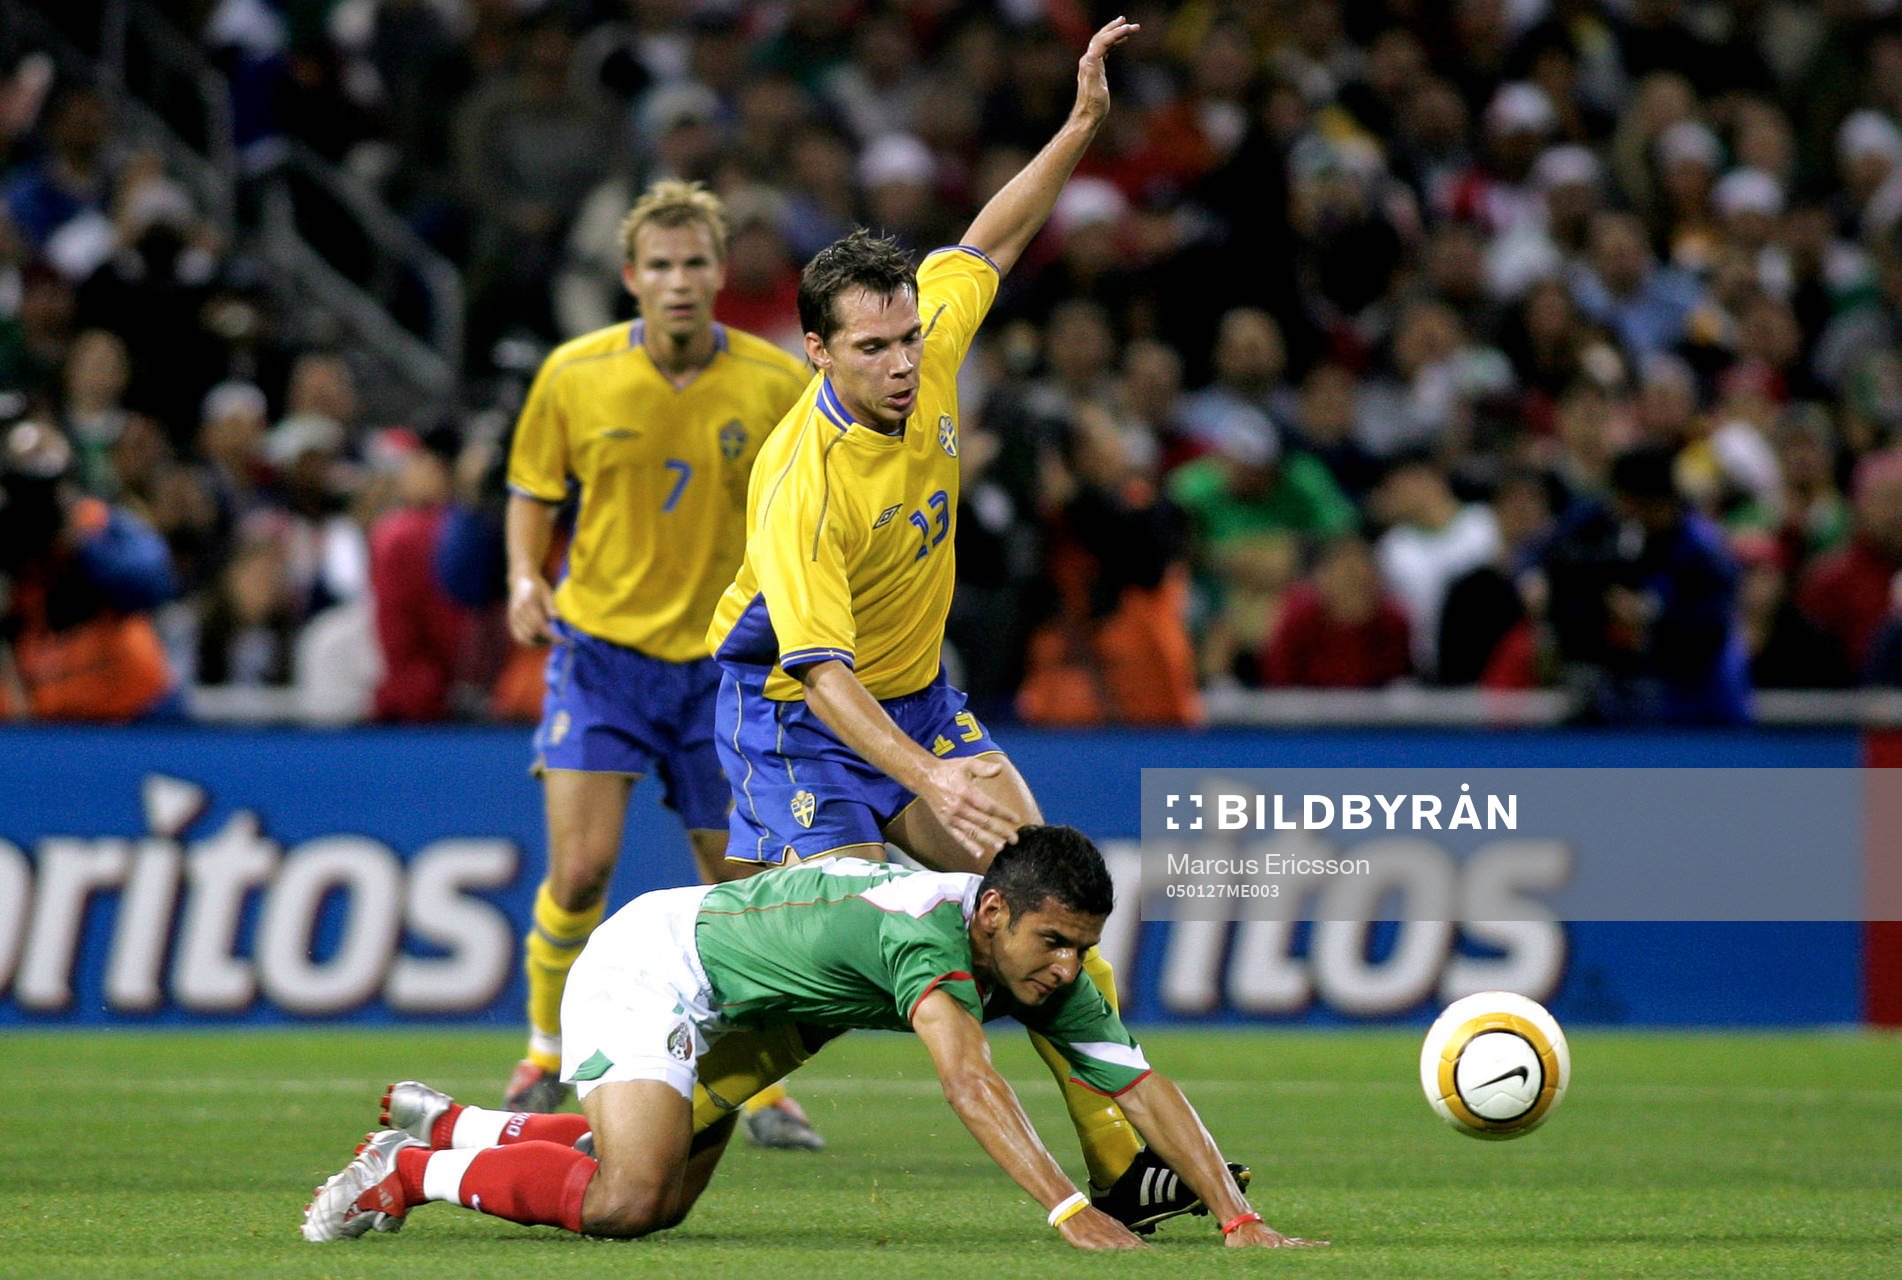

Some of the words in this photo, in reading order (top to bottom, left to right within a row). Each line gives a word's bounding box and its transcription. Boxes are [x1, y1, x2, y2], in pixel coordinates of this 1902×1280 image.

[663, 459, 692, 512] 7
[908, 490, 950, 561] 13
[0, 773, 521, 1015] ritos
